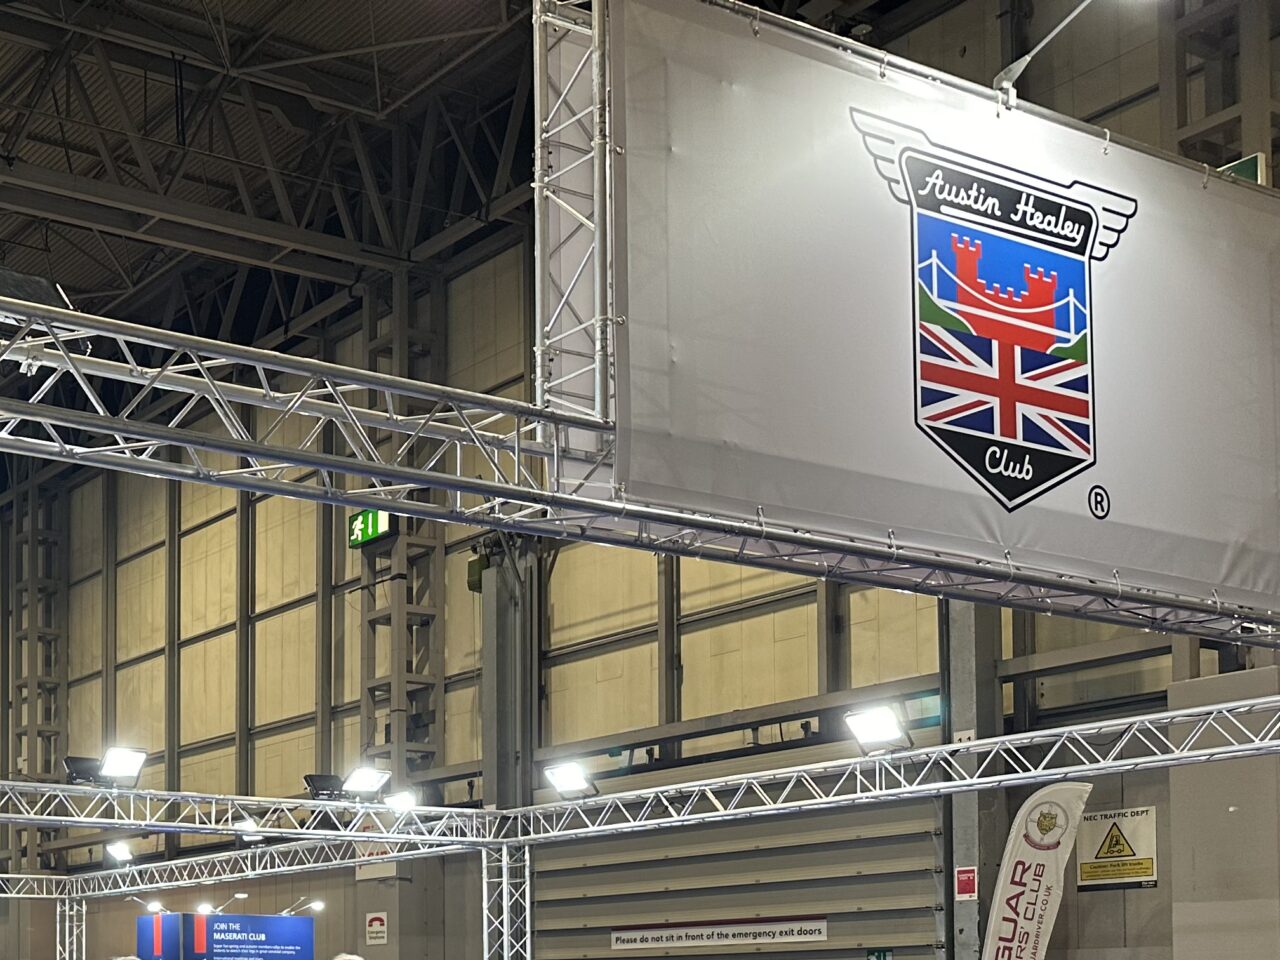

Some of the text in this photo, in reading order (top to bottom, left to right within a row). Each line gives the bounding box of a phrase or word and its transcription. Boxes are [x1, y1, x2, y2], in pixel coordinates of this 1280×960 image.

[918, 169, 1086, 242] Austin Healey
[985, 445, 1033, 480] Club
[1100, 811, 1128, 820] TRAFFIC
[1131, 809, 1150, 817] DEPT
[1024, 862, 1046, 922] CLUB
[213, 922, 241, 931] JOIN THE
[213, 932, 266, 941] MASERATI CLUB
[615, 936, 637, 945] Please
[639, 935, 649, 943] do
[651, 935, 664, 943] not
[665, 934, 674, 942] sit
[685, 932, 704, 941] front
[706, 932, 714, 940] of
[716, 931, 729, 940] the
[731, 929, 776, 940] emergency
[778, 928, 795, 937] exit
[797, 927, 822, 936] doors
